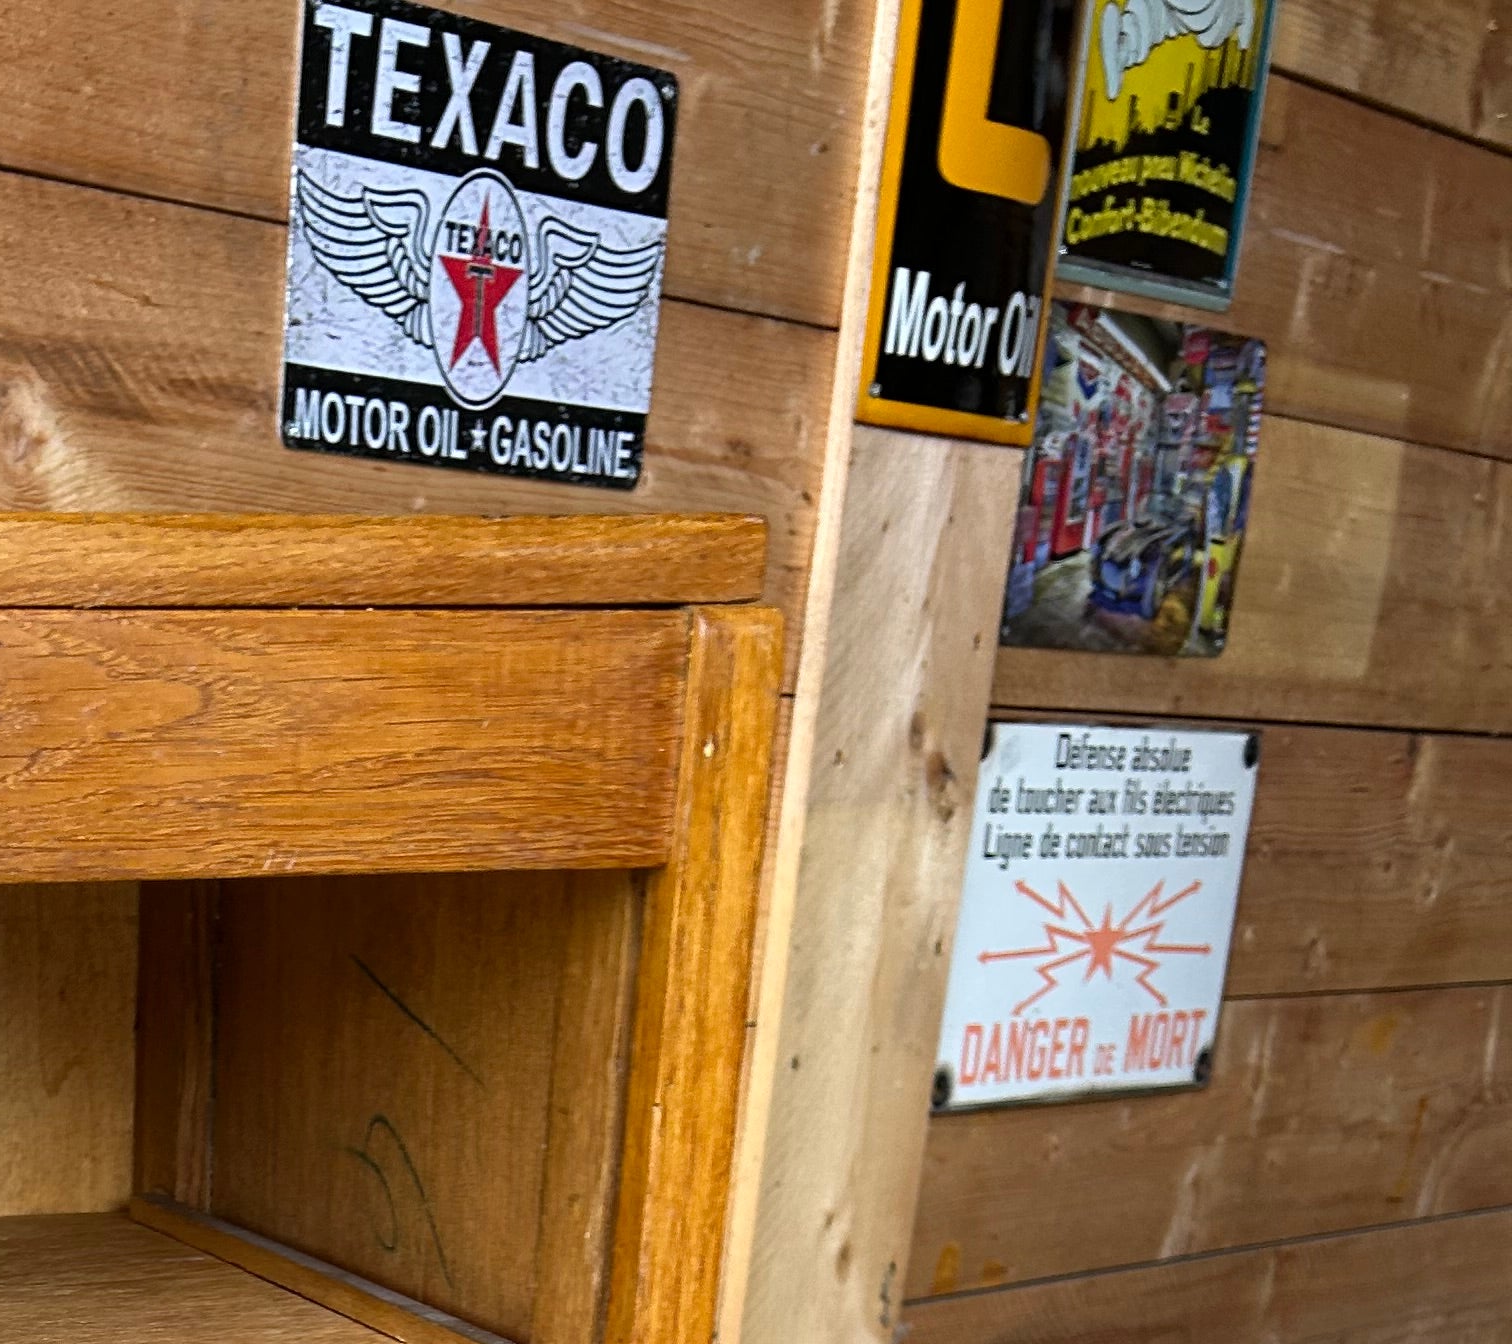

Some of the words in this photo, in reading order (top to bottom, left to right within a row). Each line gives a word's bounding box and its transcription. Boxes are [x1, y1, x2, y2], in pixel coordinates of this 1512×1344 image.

[313, 3, 666, 194] TEXACO
[445, 220, 524, 264] TEXACO
[884, 266, 999, 369] Motor
[998, 290, 1042, 378] Oil
[294, 388, 410, 452] MOTOR
[418, 405, 469, 460] OIL
[491, 415, 638, 481] GASOLINE
[1131, 736, 1193, 772] absolue
[988, 776, 1011, 814] de
[1016, 777, 1085, 815] toucher
[1087, 788, 1119, 815] aux
[1122, 778, 1149, 815] fils
[984, 823, 1034, 871] Ligne
[1039, 822, 1062, 858] de
[1065, 823, 1131, 859] contact
[1134, 832, 1172, 858] sous
[1175, 823, 1231, 858] tension
[958, 1016, 1091, 1085] DANGER
[1093, 1043, 1117, 1076] DE
[1123, 1009, 1208, 1074] MORT
